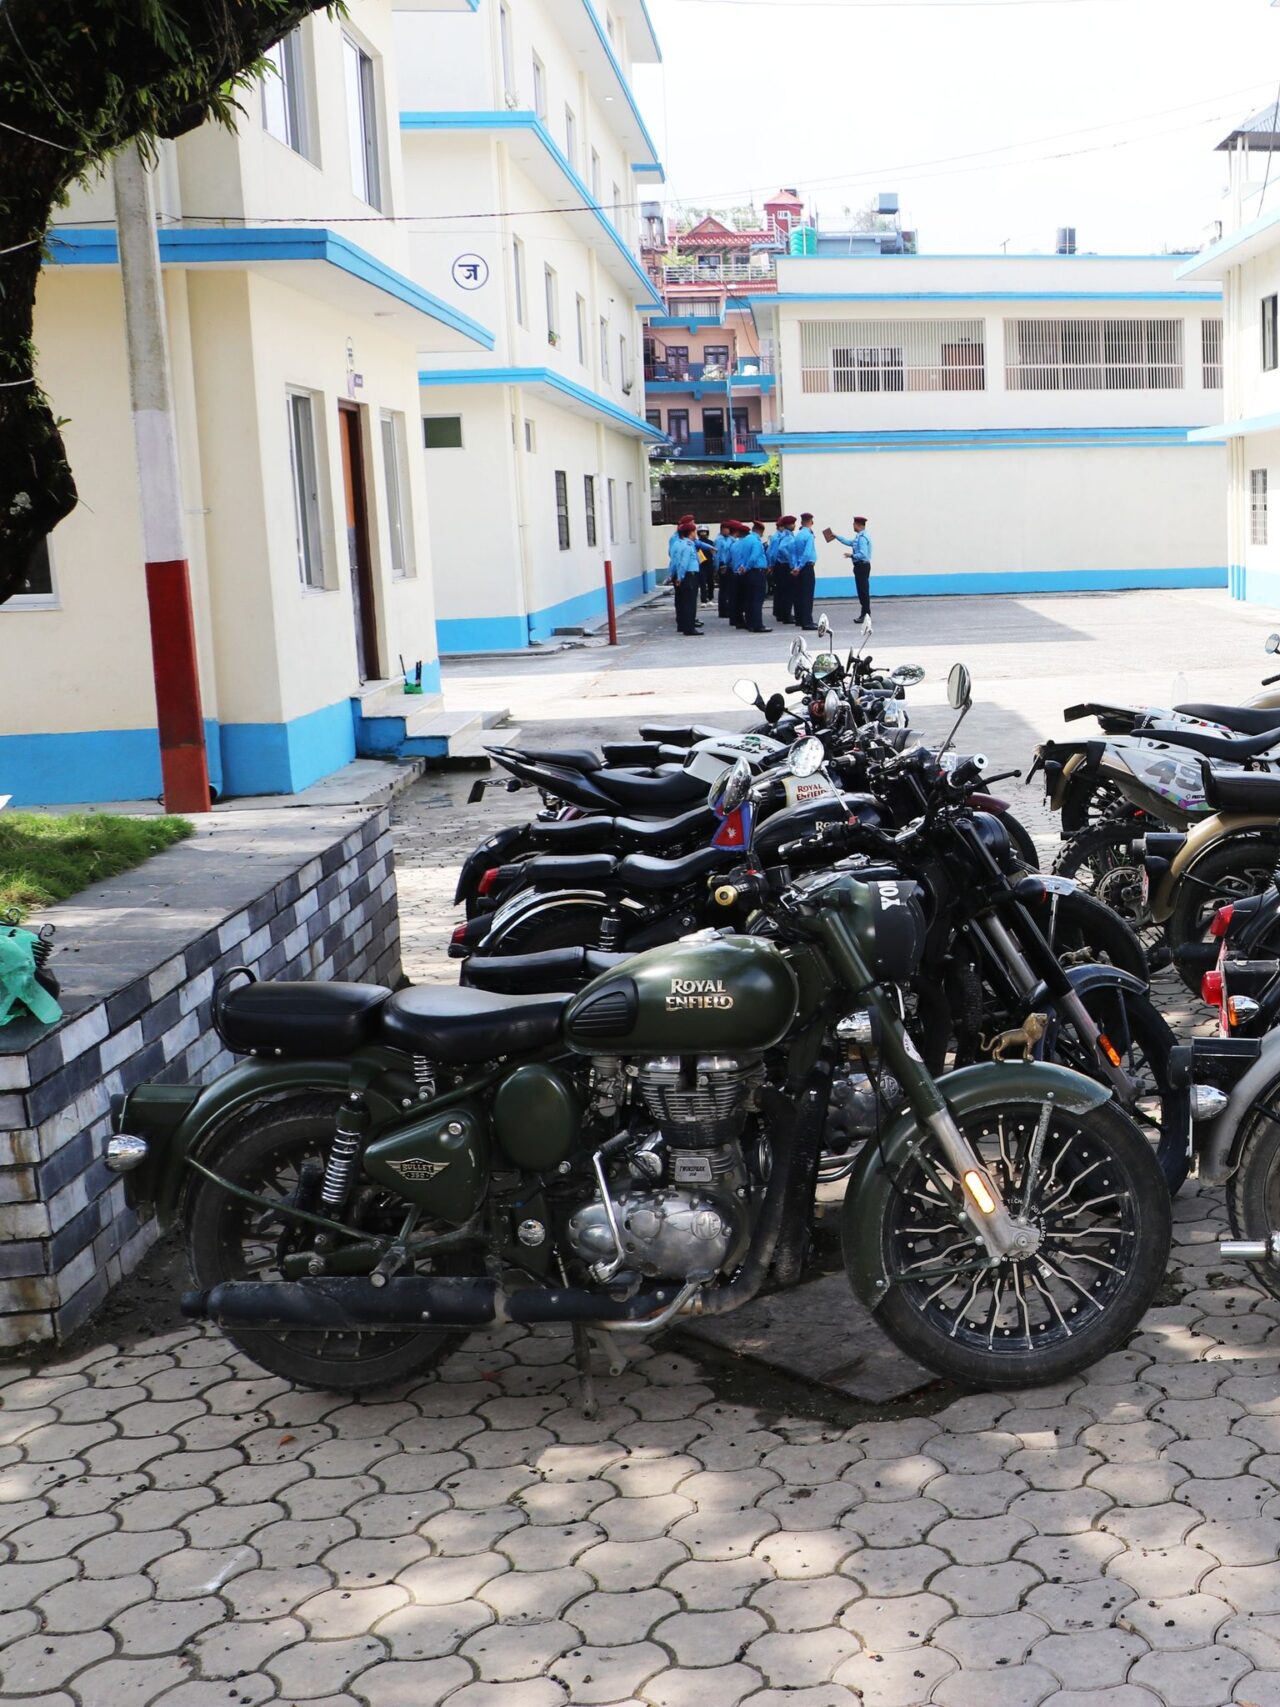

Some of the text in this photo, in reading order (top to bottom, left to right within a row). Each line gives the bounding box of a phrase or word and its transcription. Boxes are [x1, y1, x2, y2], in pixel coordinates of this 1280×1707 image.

[458, 264, 480, 281] ज
[797, 783, 824, 793] ROYAL
[671, 979, 727, 995] ROYAL
[665, 996, 734, 1012] ENFIELD
